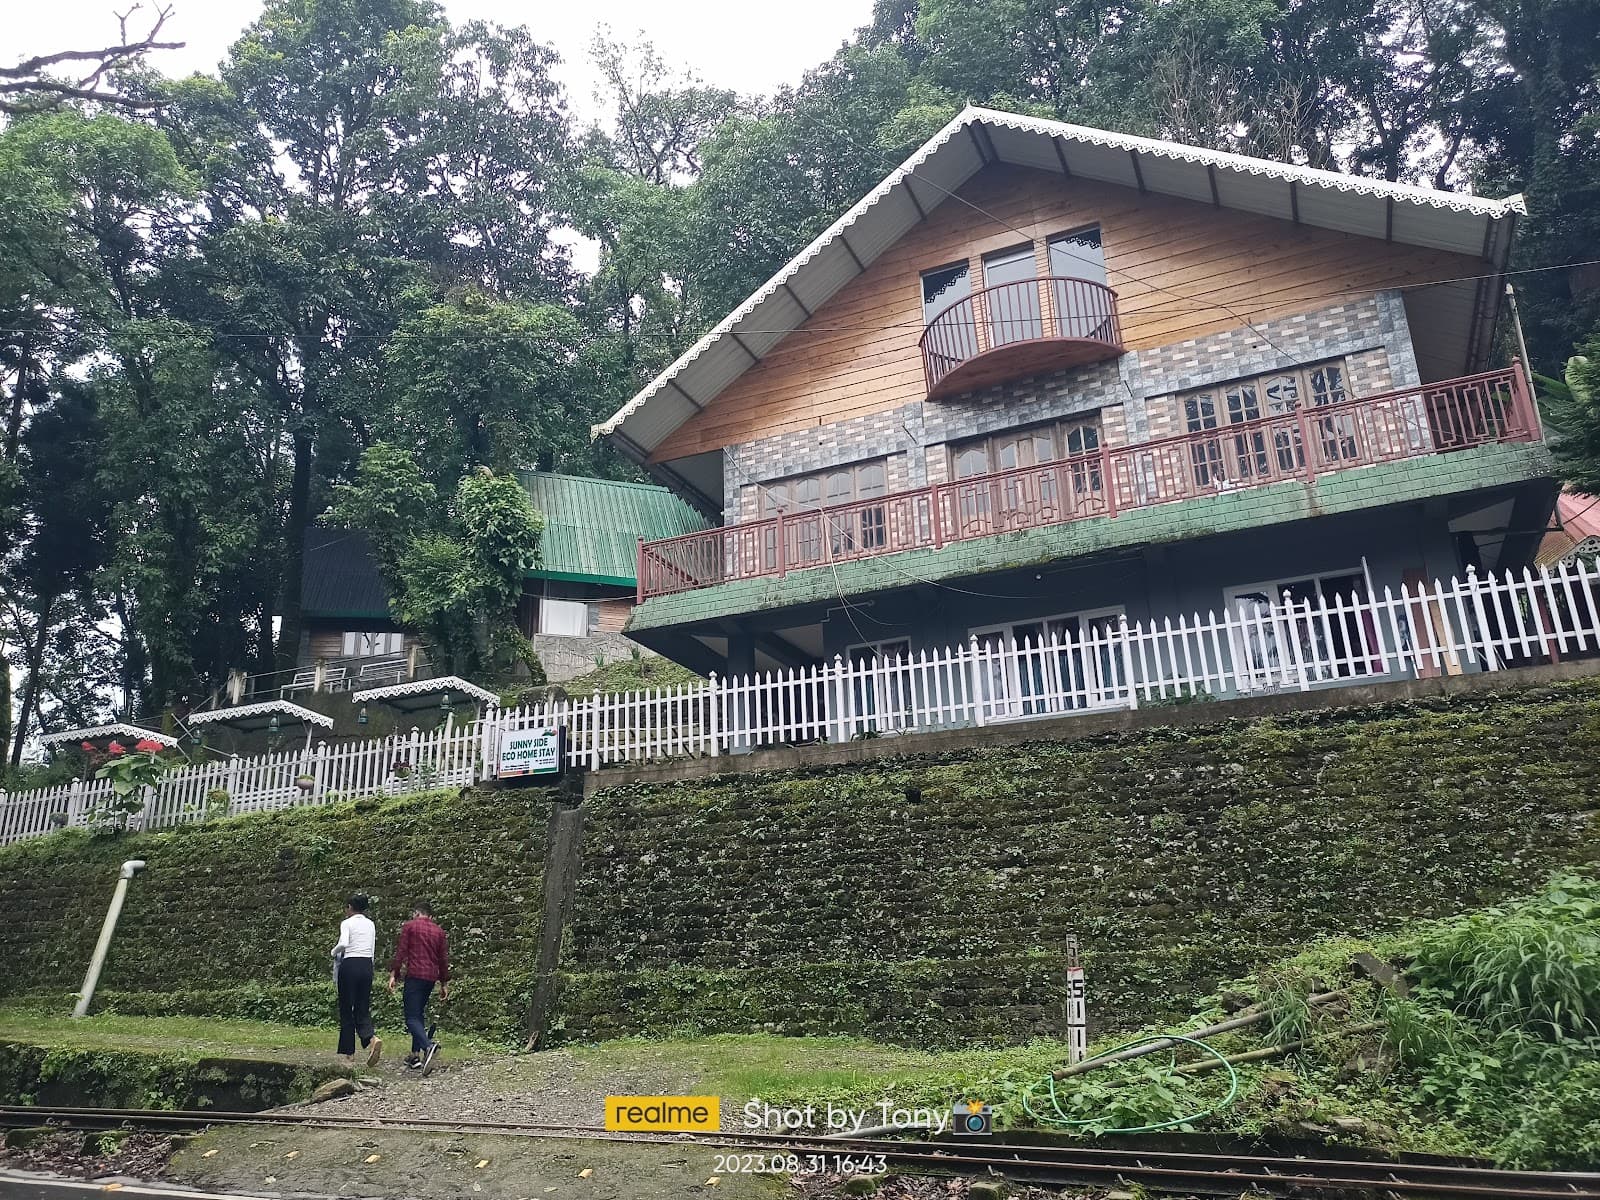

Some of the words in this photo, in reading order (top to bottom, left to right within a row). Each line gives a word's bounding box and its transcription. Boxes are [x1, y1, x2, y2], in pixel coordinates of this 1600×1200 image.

[510, 740, 532, 750] SUNNY
[533, 738, 548, 747] SIDE
[502, 752, 516, 761] ECO
[517, 749, 537, 759] HOME
[539, 747, 555, 757] STAY
